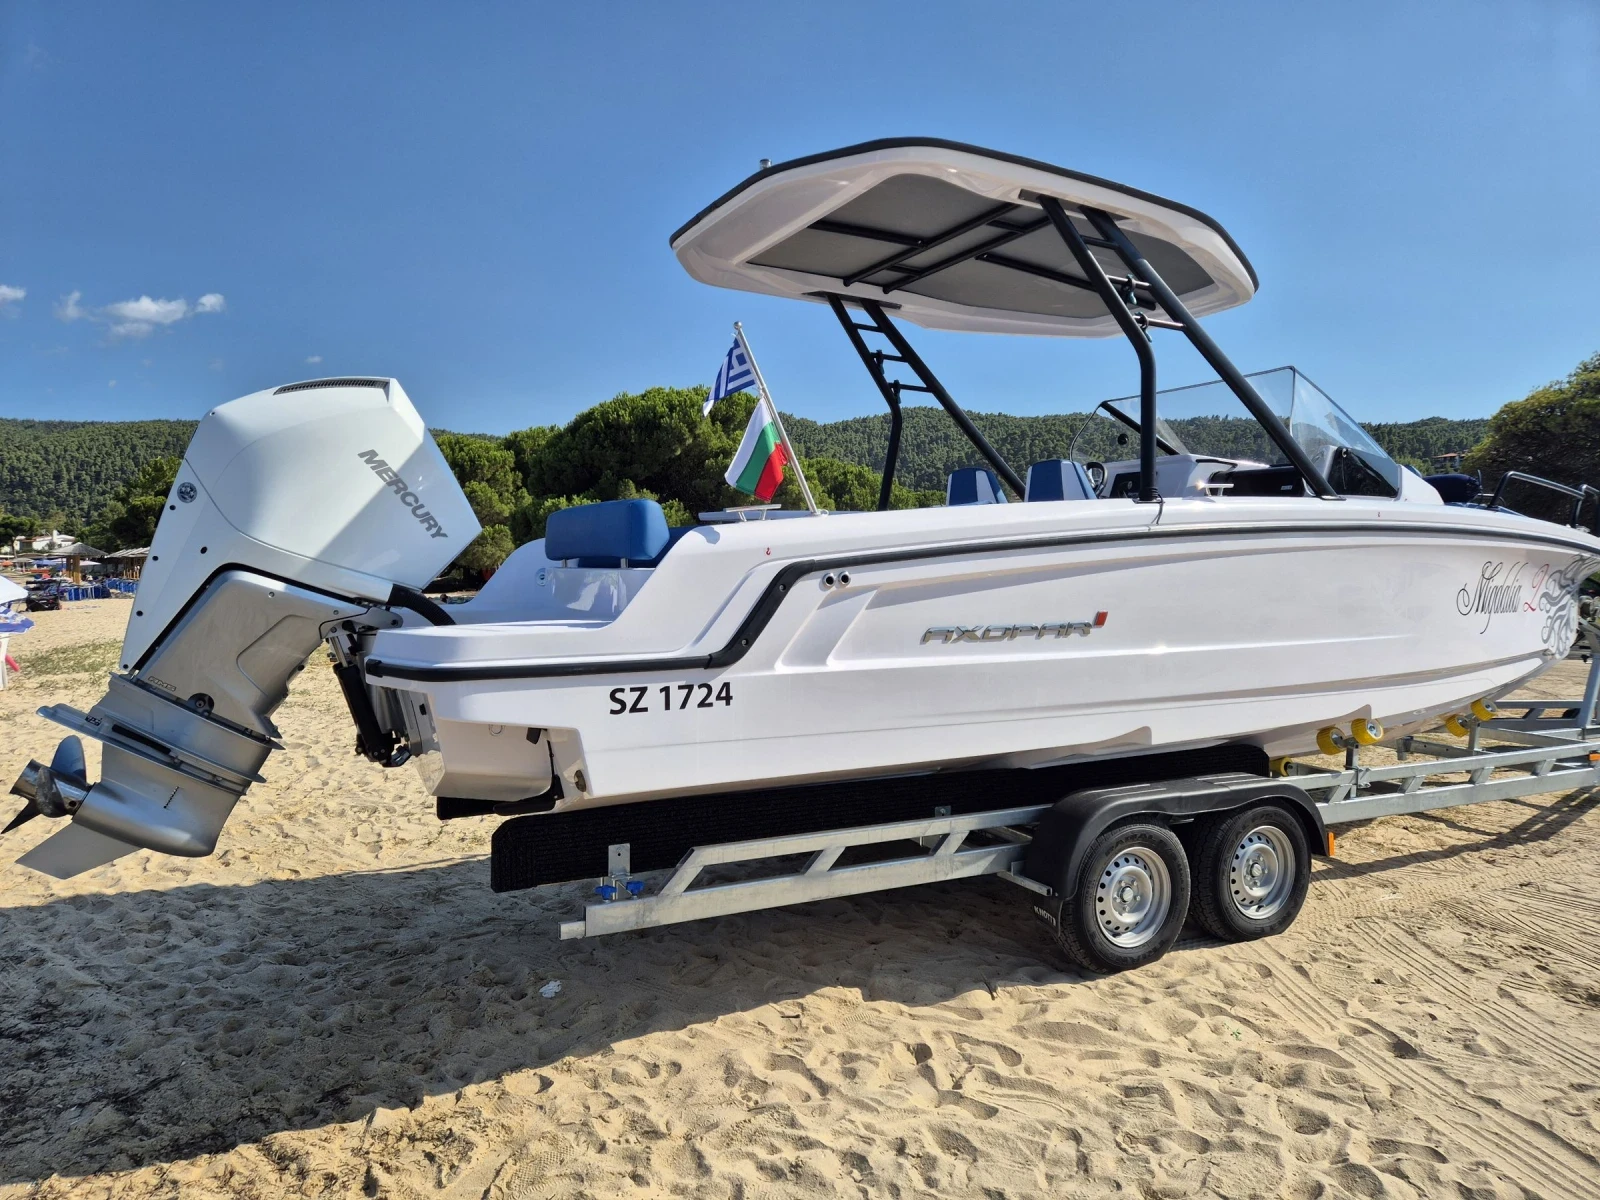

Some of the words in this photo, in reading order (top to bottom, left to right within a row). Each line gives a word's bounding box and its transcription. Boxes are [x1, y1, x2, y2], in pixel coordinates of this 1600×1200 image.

[357, 449, 449, 539] MERCURY
[1457, 560, 1528, 634] Migdalia
[1523, 563, 1550, 612] 2
[919, 619, 1093, 645] AXOPAR
[609, 687, 649, 715] SZ
[659, 681, 733, 711] 1724
